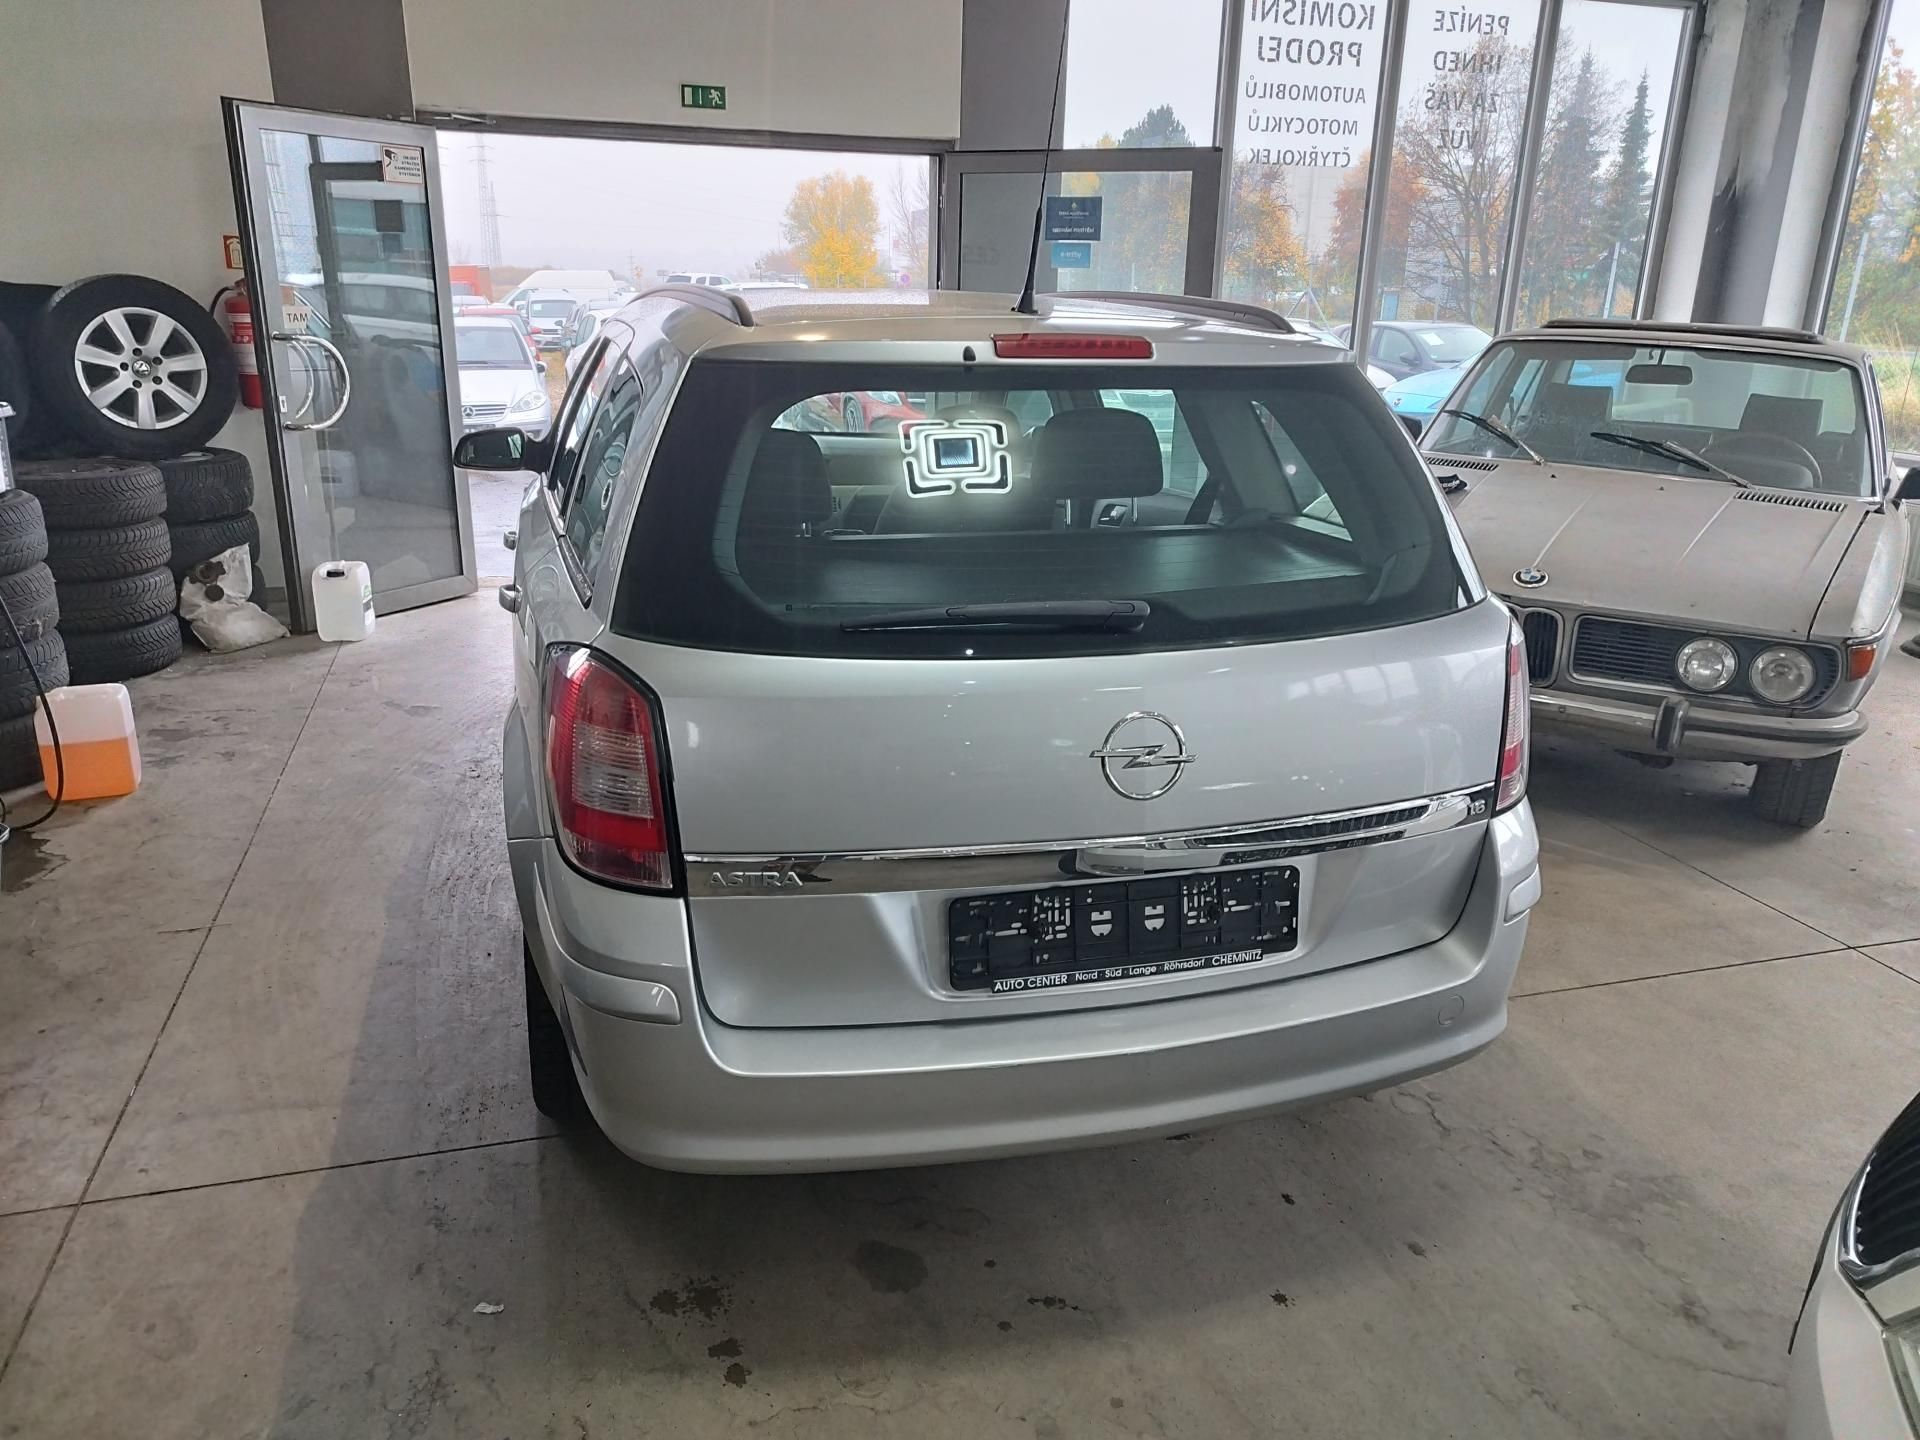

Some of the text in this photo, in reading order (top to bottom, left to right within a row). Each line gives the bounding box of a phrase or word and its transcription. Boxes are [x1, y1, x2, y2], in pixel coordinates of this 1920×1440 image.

[286, 313, 308, 323] TAM
[710, 871, 804, 888] ASTRA
[993, 950, 1262, 993] AUTO CENTER Nord Süd Lange Röhrsdorf CHEMNITZ
